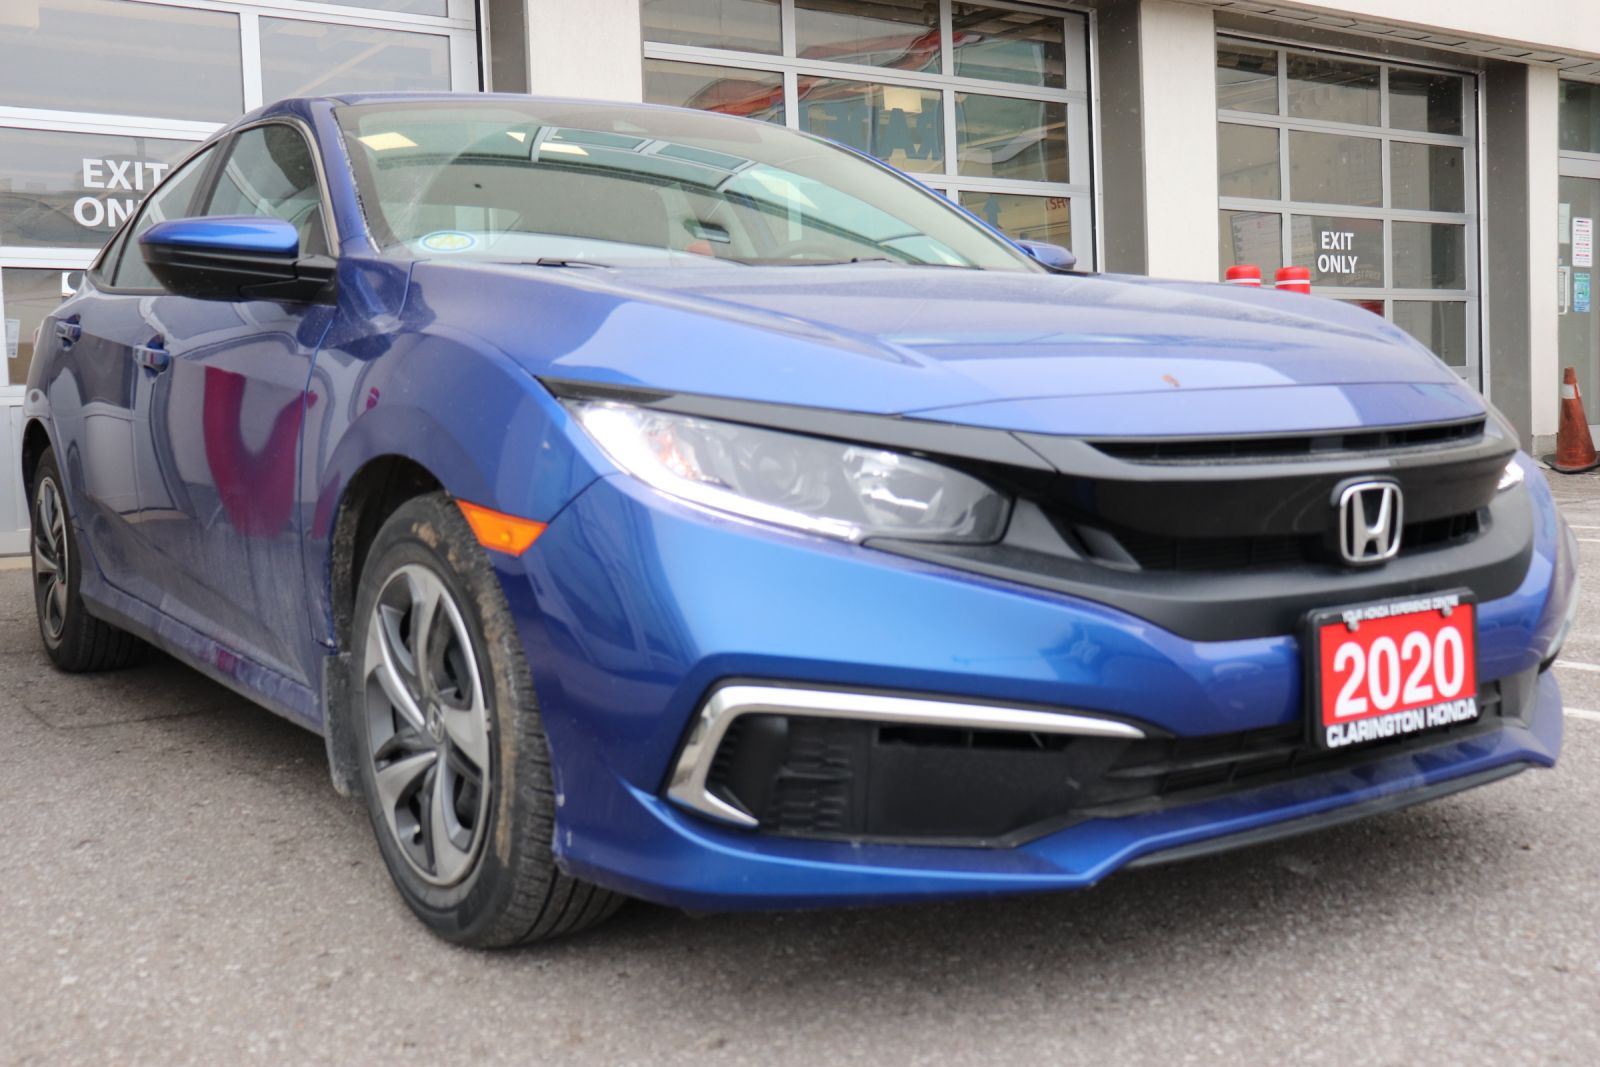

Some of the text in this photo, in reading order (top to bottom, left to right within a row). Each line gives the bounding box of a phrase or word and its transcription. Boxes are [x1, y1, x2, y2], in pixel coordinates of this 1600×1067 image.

[83, 158, 168, 190] EXIT
[73, 196, 145, 227] ON
[1321, 231, 1354, 250] EXIT
[1317, 254, 1358, 273] ONLY
[1333, 626, 1465, 718] 2020
[1326, 697, 1478, 748] CLARINGTON HONDA
